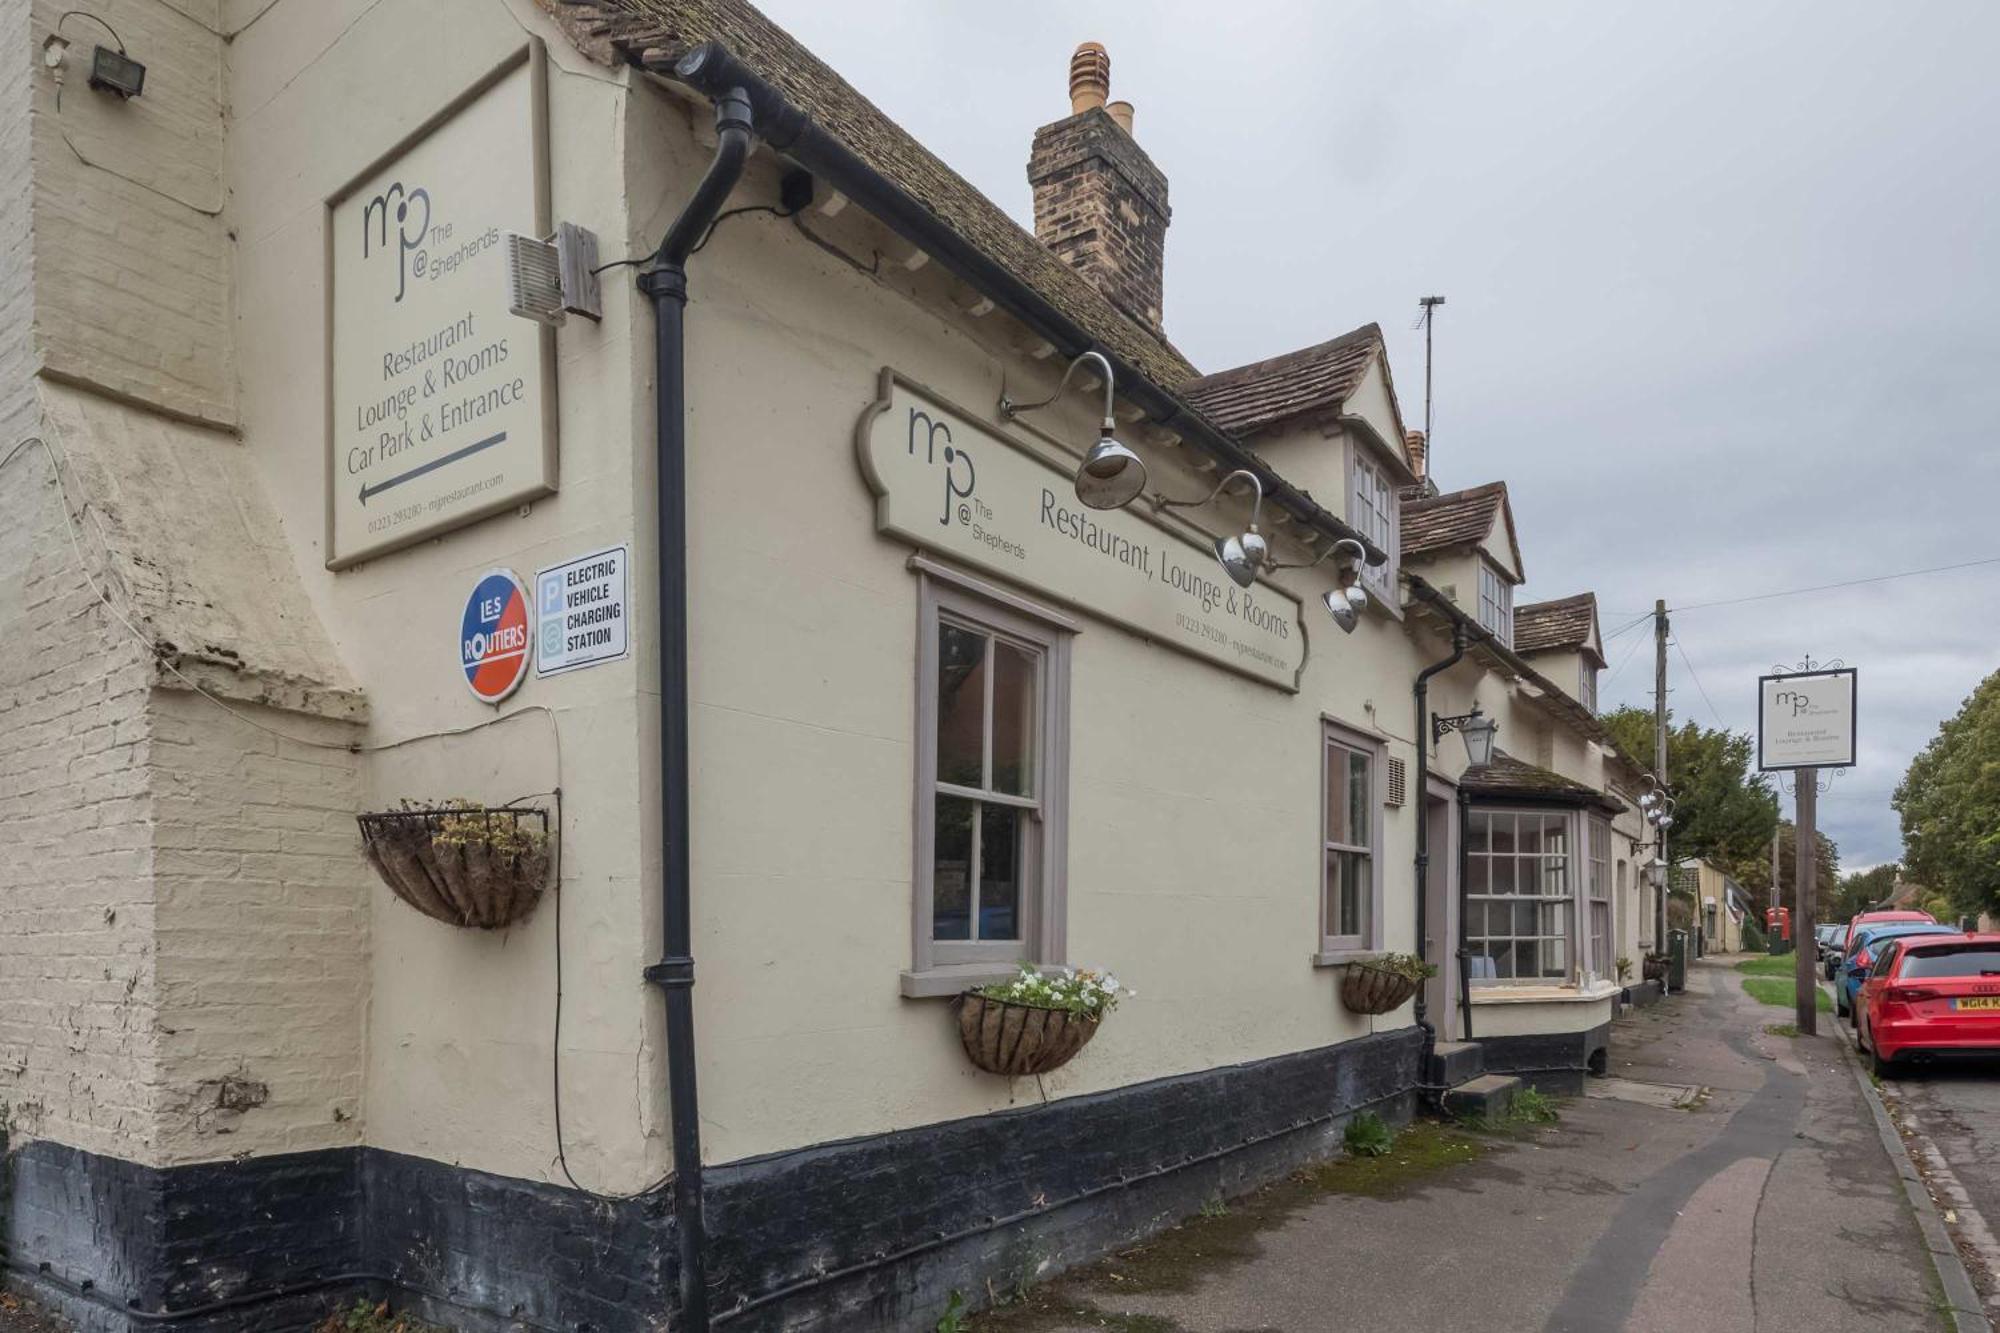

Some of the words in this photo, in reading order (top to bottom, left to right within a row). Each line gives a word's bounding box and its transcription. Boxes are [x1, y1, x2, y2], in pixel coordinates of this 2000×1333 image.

[430, 223, 453, 247] The
[412, 249, 428, 278] @
[430, 227, 500, 280] Shepherds
[383, 311, 476, 381] Restaurant
[358, 385, 417, 432] Lounge
[423, 369, 436, 398] &
[443, 338, 509, 388] Rooms
[348, 446, 374, 475] Car
[380, 420, 414, 461] Park
[420, 413, 434, 442] &
[440, 378, 523, 432] Entrance
[957, 503, 972, 526] @
[973, 497, 993, 521] The
[972, 523, 1026, 560] Shepherds
[567, 559, 616, 587] ELECTRIC
[1040, 487, 1154, 579] Restaurant,
[1160, 550, 1222, 614] Lounge
[1225, 585, 1238, 616] &
[1243, 592, 1288, 640] Rooms
[480, 596, 501, 623] LES
[567, 583, 609, 608] VEHICLE
[567, 602, 621, 630] CHARGING
[464, 624, 525, 660] ROUTIERS
[567, 627, 612, 652] STATION
